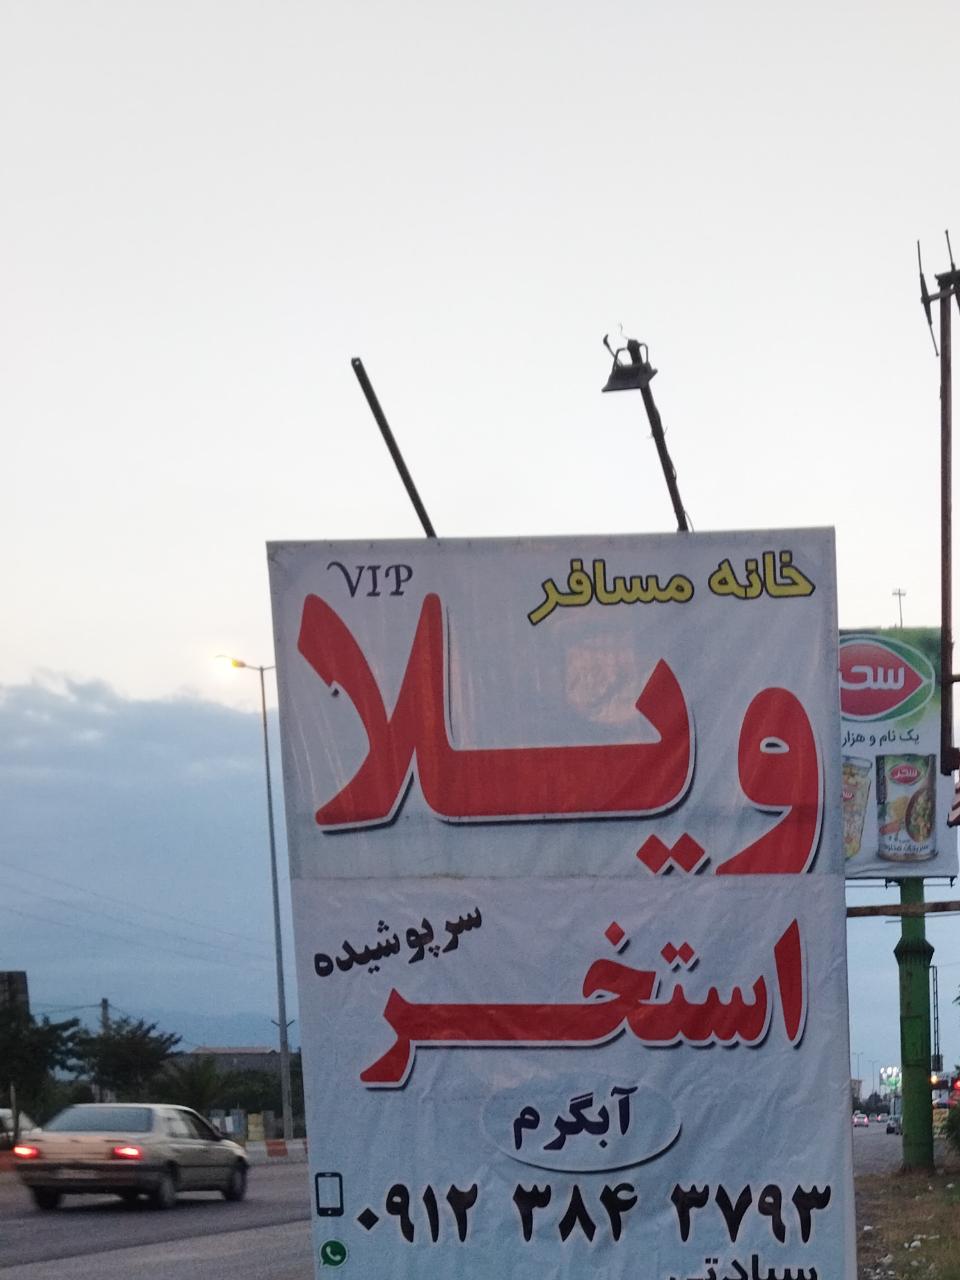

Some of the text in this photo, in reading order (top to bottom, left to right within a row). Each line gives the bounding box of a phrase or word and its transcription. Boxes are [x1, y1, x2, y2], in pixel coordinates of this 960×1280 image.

[327, 561, 413, 597] VIP
[528, 551, 815, 625] خانه مسافر
[297, 592, 824, 876] ویلا
[841, 728, 920, 747] یک نام و هزار
[359, 918, 808, 1090] استخر
[512, 1086, 638, 1151] آبگرم
[356, 1182, 832, 1244] ۰۹۱۲ ۳۸۴ ۳۷۹۳
